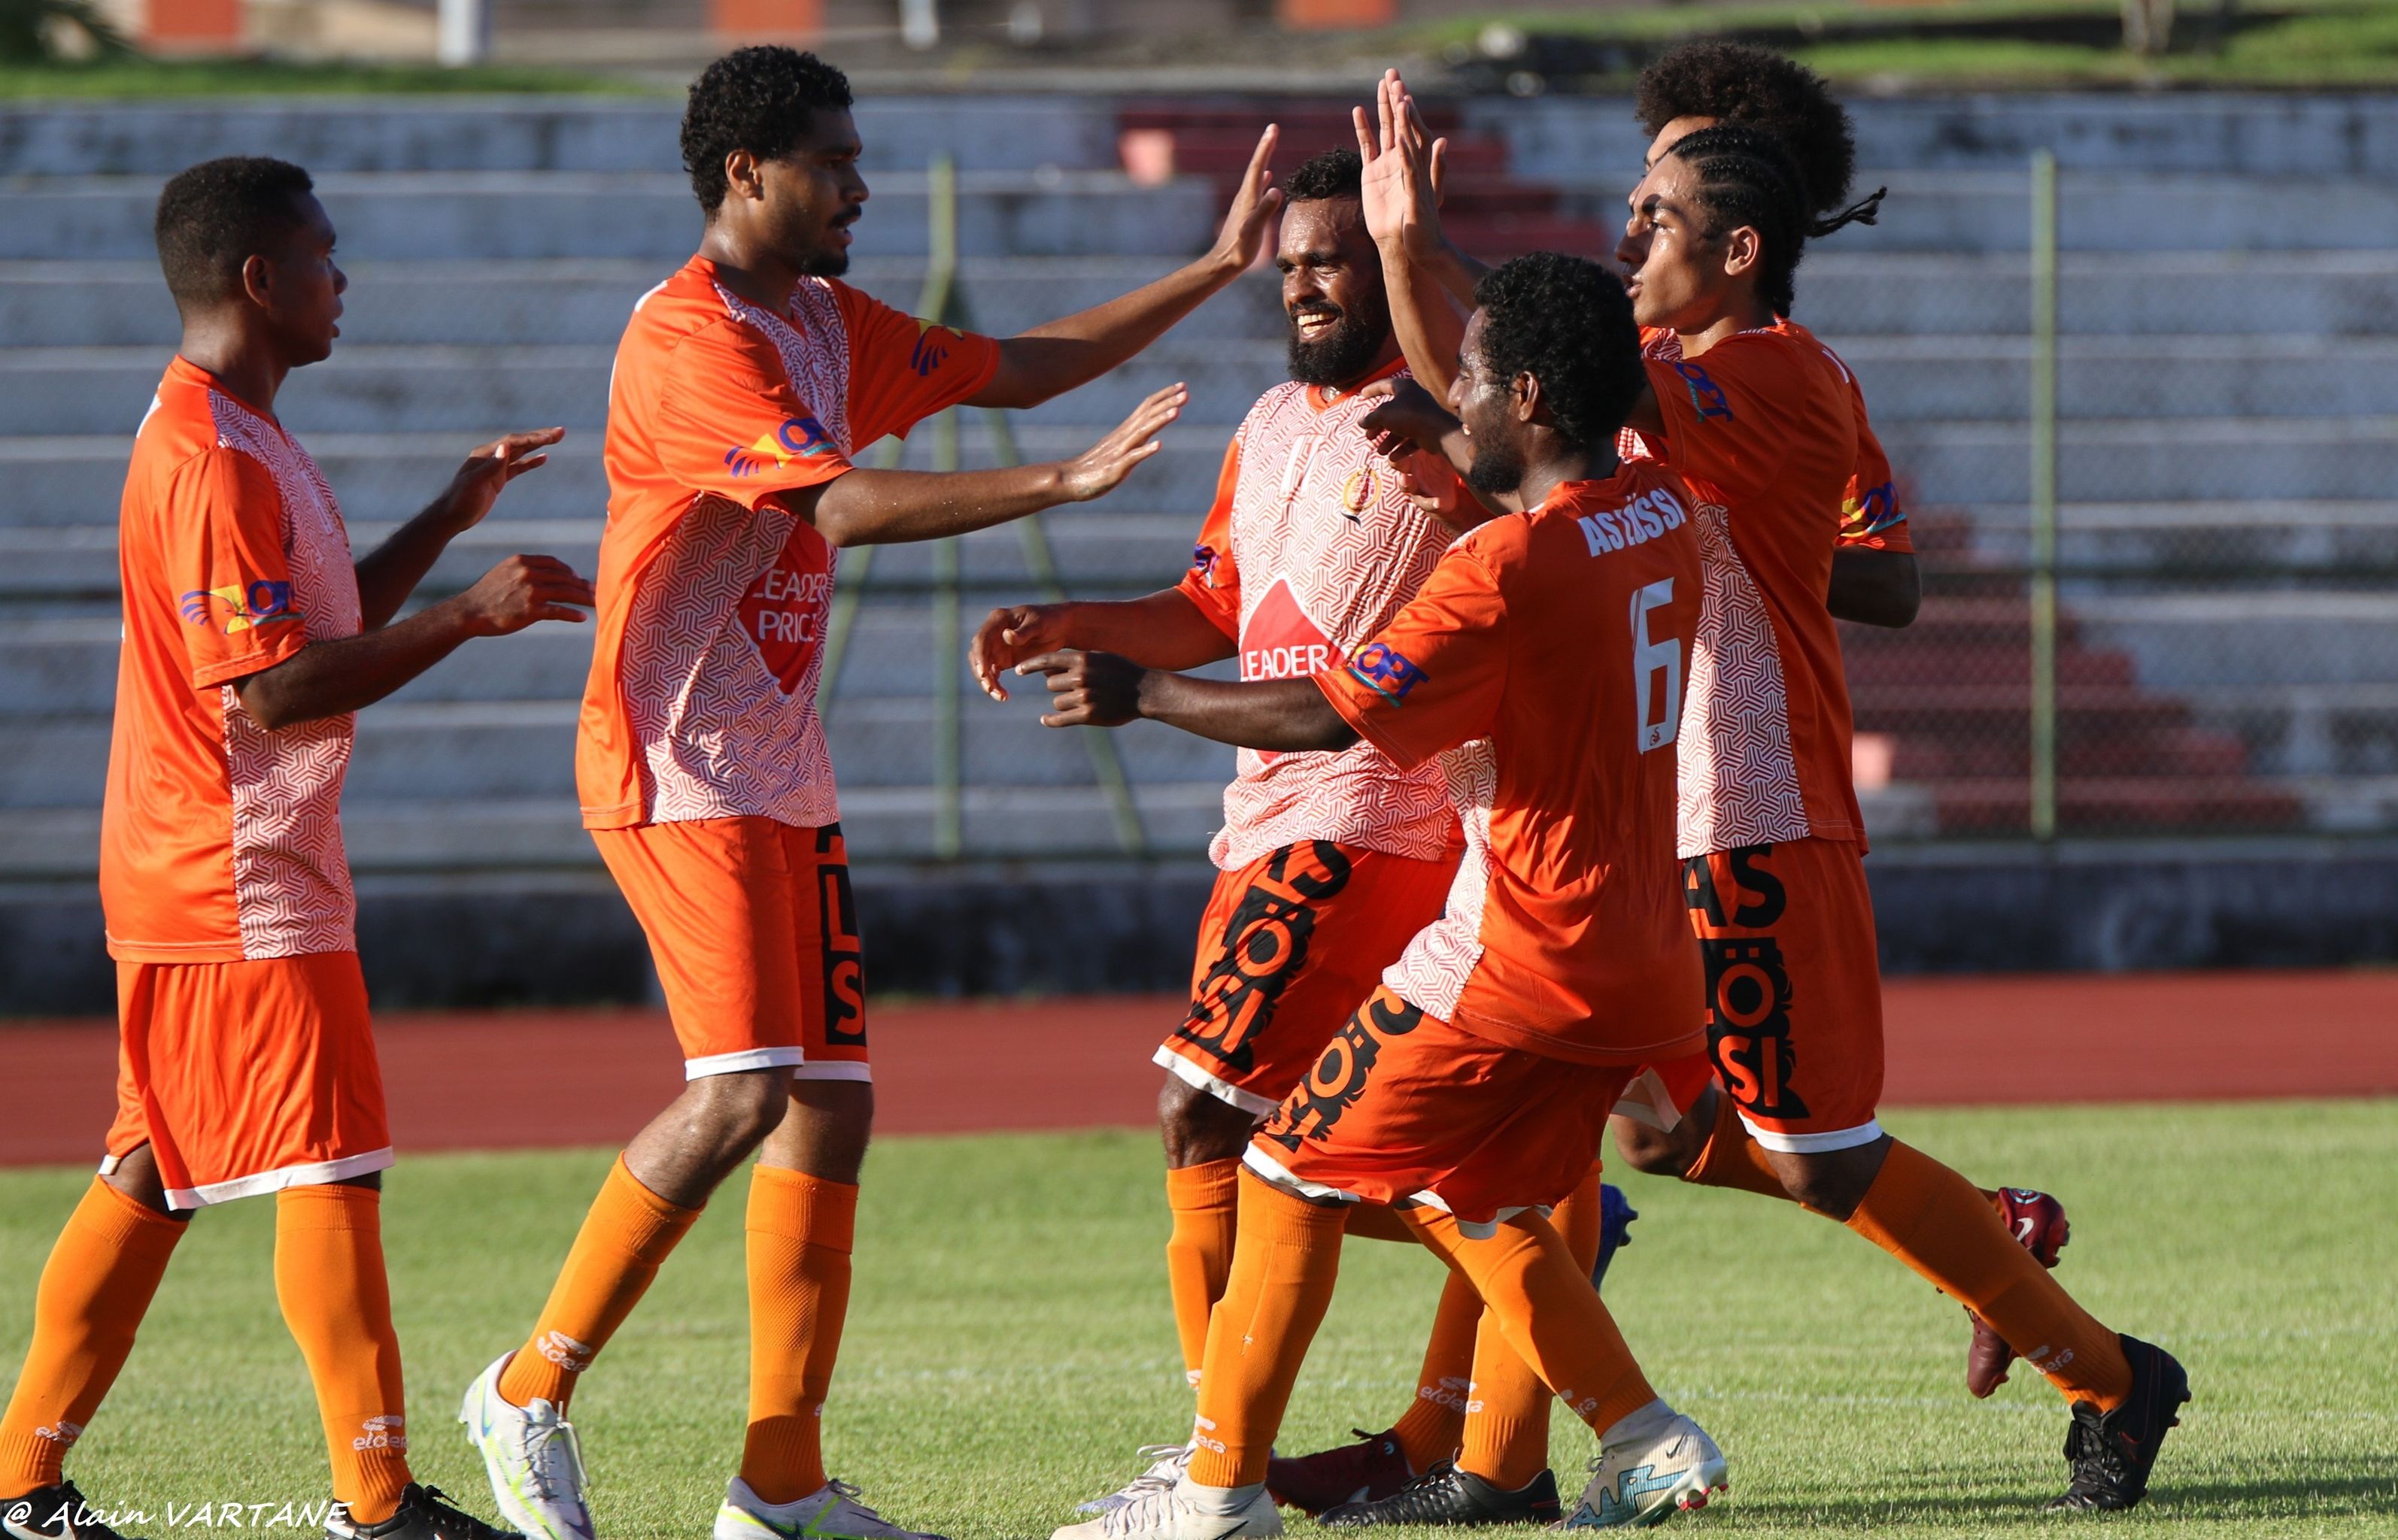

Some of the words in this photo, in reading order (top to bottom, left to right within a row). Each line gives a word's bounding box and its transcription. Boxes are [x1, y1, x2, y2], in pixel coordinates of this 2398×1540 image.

[1240, 644, 1330, 682] LEADER
[1357, 642, 1431, 699] OPT
[1629, 576, 1682, 754] 6
[353, 1431, 408, 1451] elder
